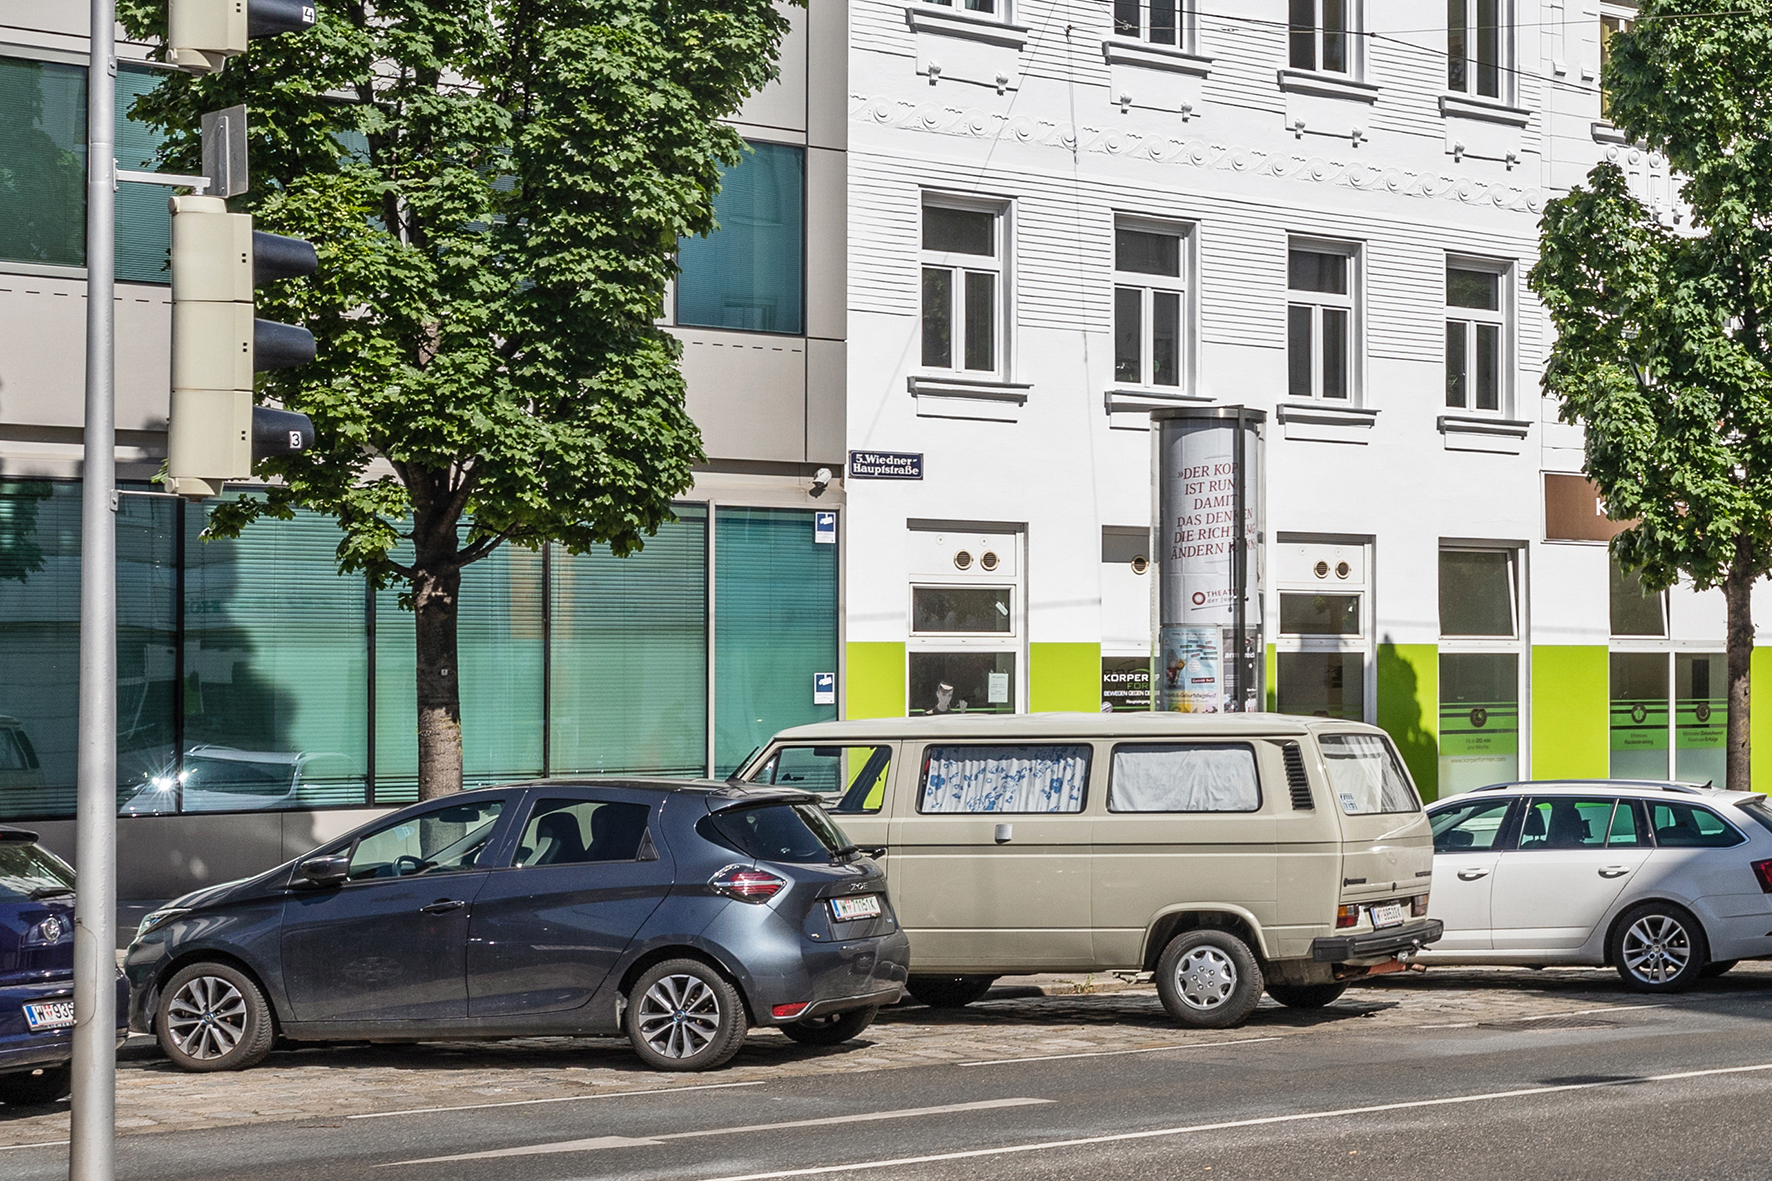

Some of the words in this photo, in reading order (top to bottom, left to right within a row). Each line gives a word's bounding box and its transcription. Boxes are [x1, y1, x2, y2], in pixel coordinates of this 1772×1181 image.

[304, 8, 314, 23] 4
[291, 433, 300, 447] 3
[853, 463, 919, 476] Hauptstraße
[1214, 462, 1239, 476] KOP
[1184, 482, 1205, 495] IST
[1209, 479, 1236, 492] RUN
[1193, 494, 1238, 510] DAMIT
[1177, 514, 1202, 527] DAS
[1174, 530, 1194, 543] DIE
[1198, 523, 1255, 540] RICHTNG
[1171, 543, 1224, 560] ÄNDERN
[35, 1006, 46, 1021] W
